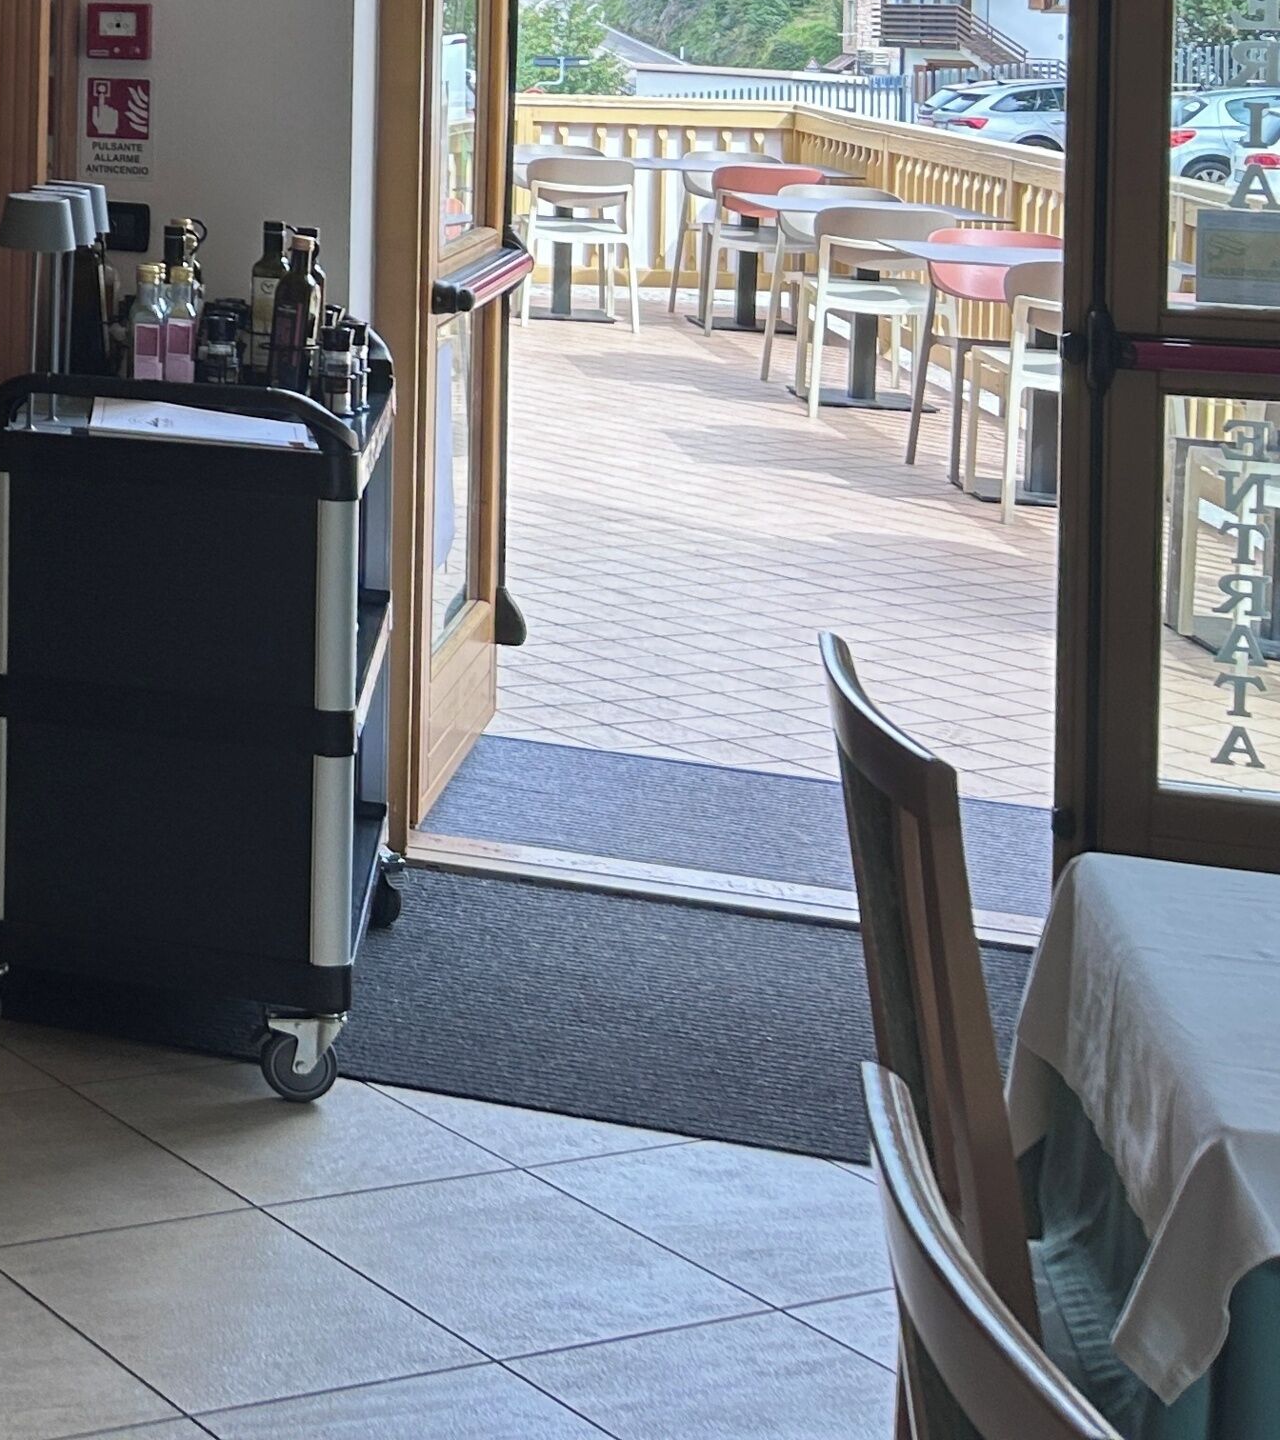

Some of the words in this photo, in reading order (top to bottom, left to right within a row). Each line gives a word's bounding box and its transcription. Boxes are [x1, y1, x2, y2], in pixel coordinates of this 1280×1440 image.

[91, 141, 144, 152] PULSANTE
[93, 153, 141, 164] ALLARME
[85, 163, 149, 176] ANTINCENDIO
